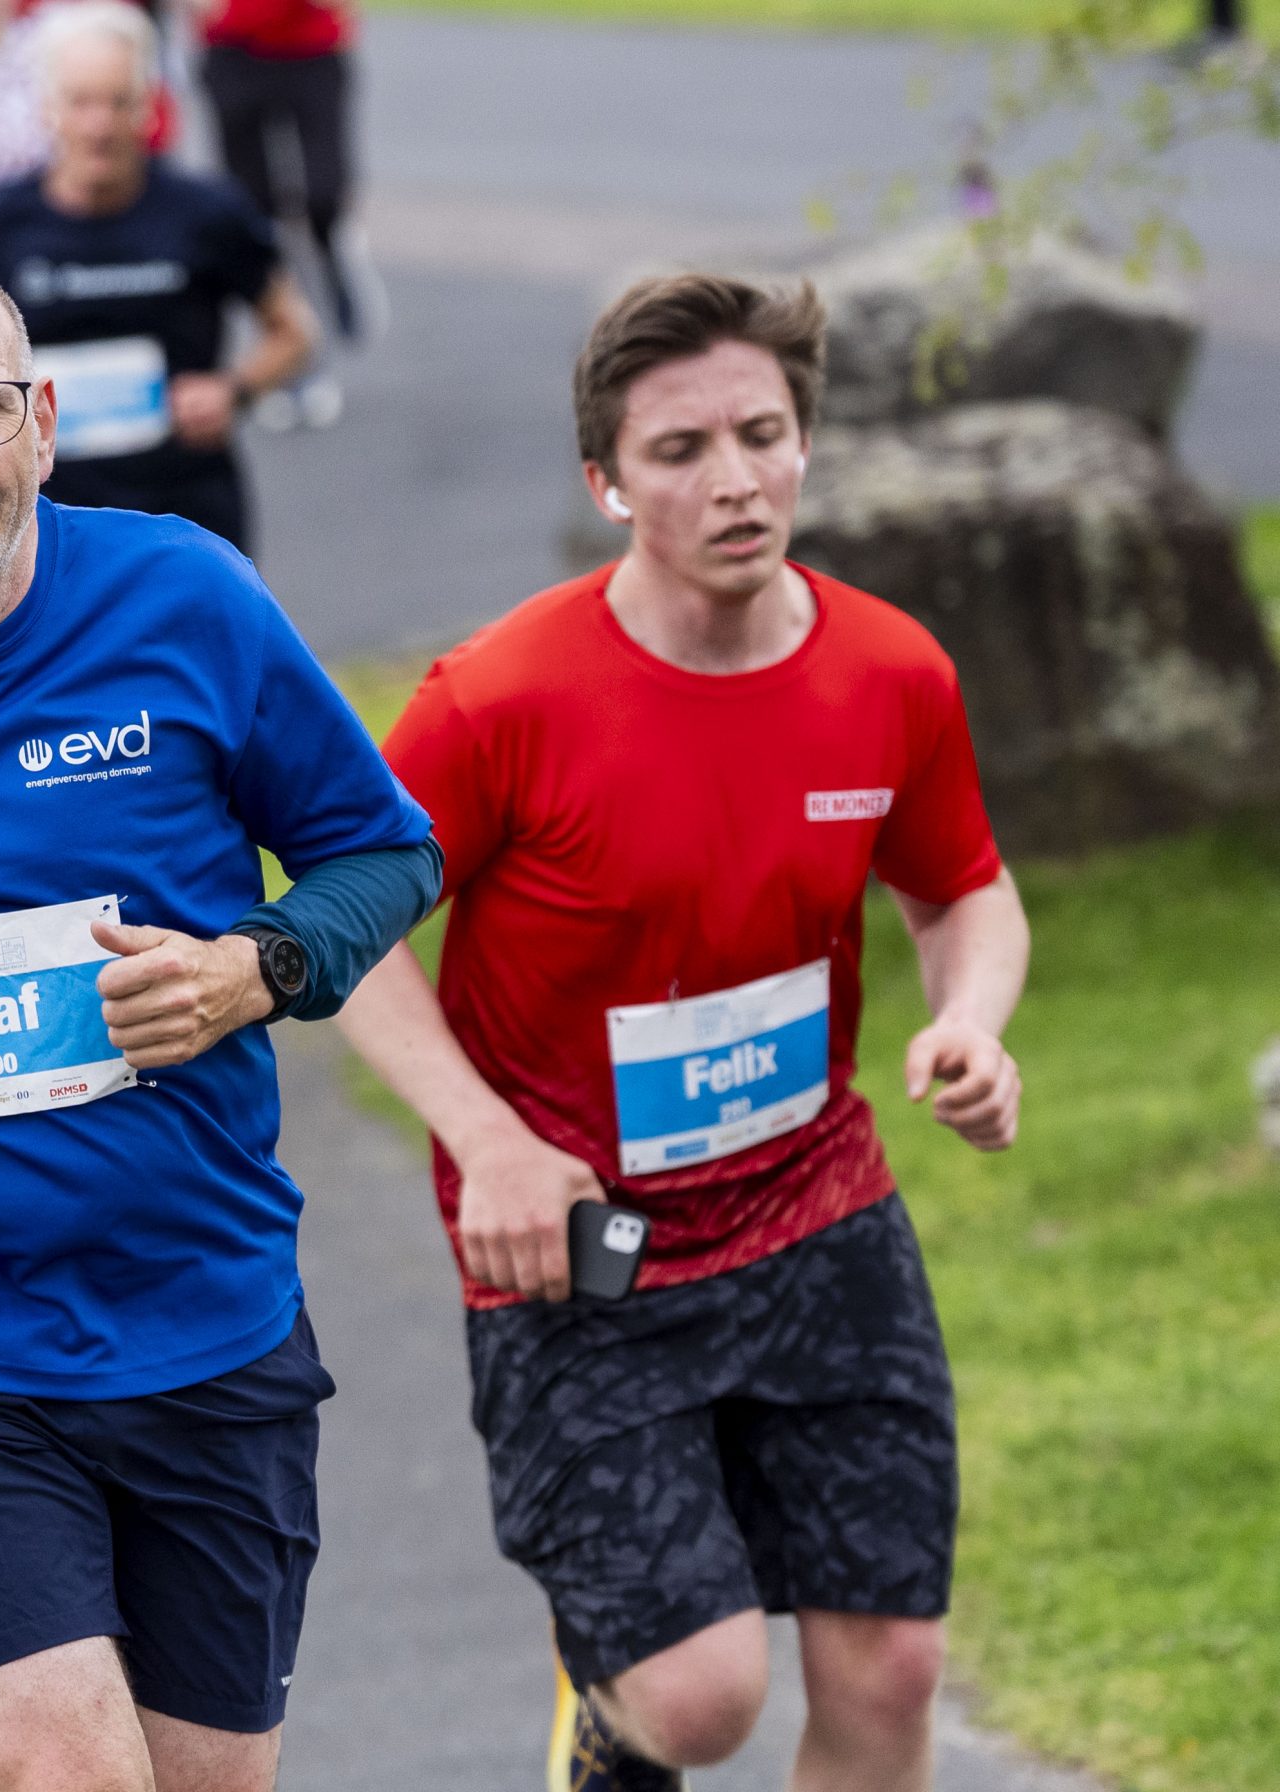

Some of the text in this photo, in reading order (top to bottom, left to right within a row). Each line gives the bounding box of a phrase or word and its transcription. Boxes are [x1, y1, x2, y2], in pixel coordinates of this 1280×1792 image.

[59, 710, 150, 765] evd
[25, 765, 152, 788] energieversorgung dormagen
[683, 1041, 778, 1100] Felix
